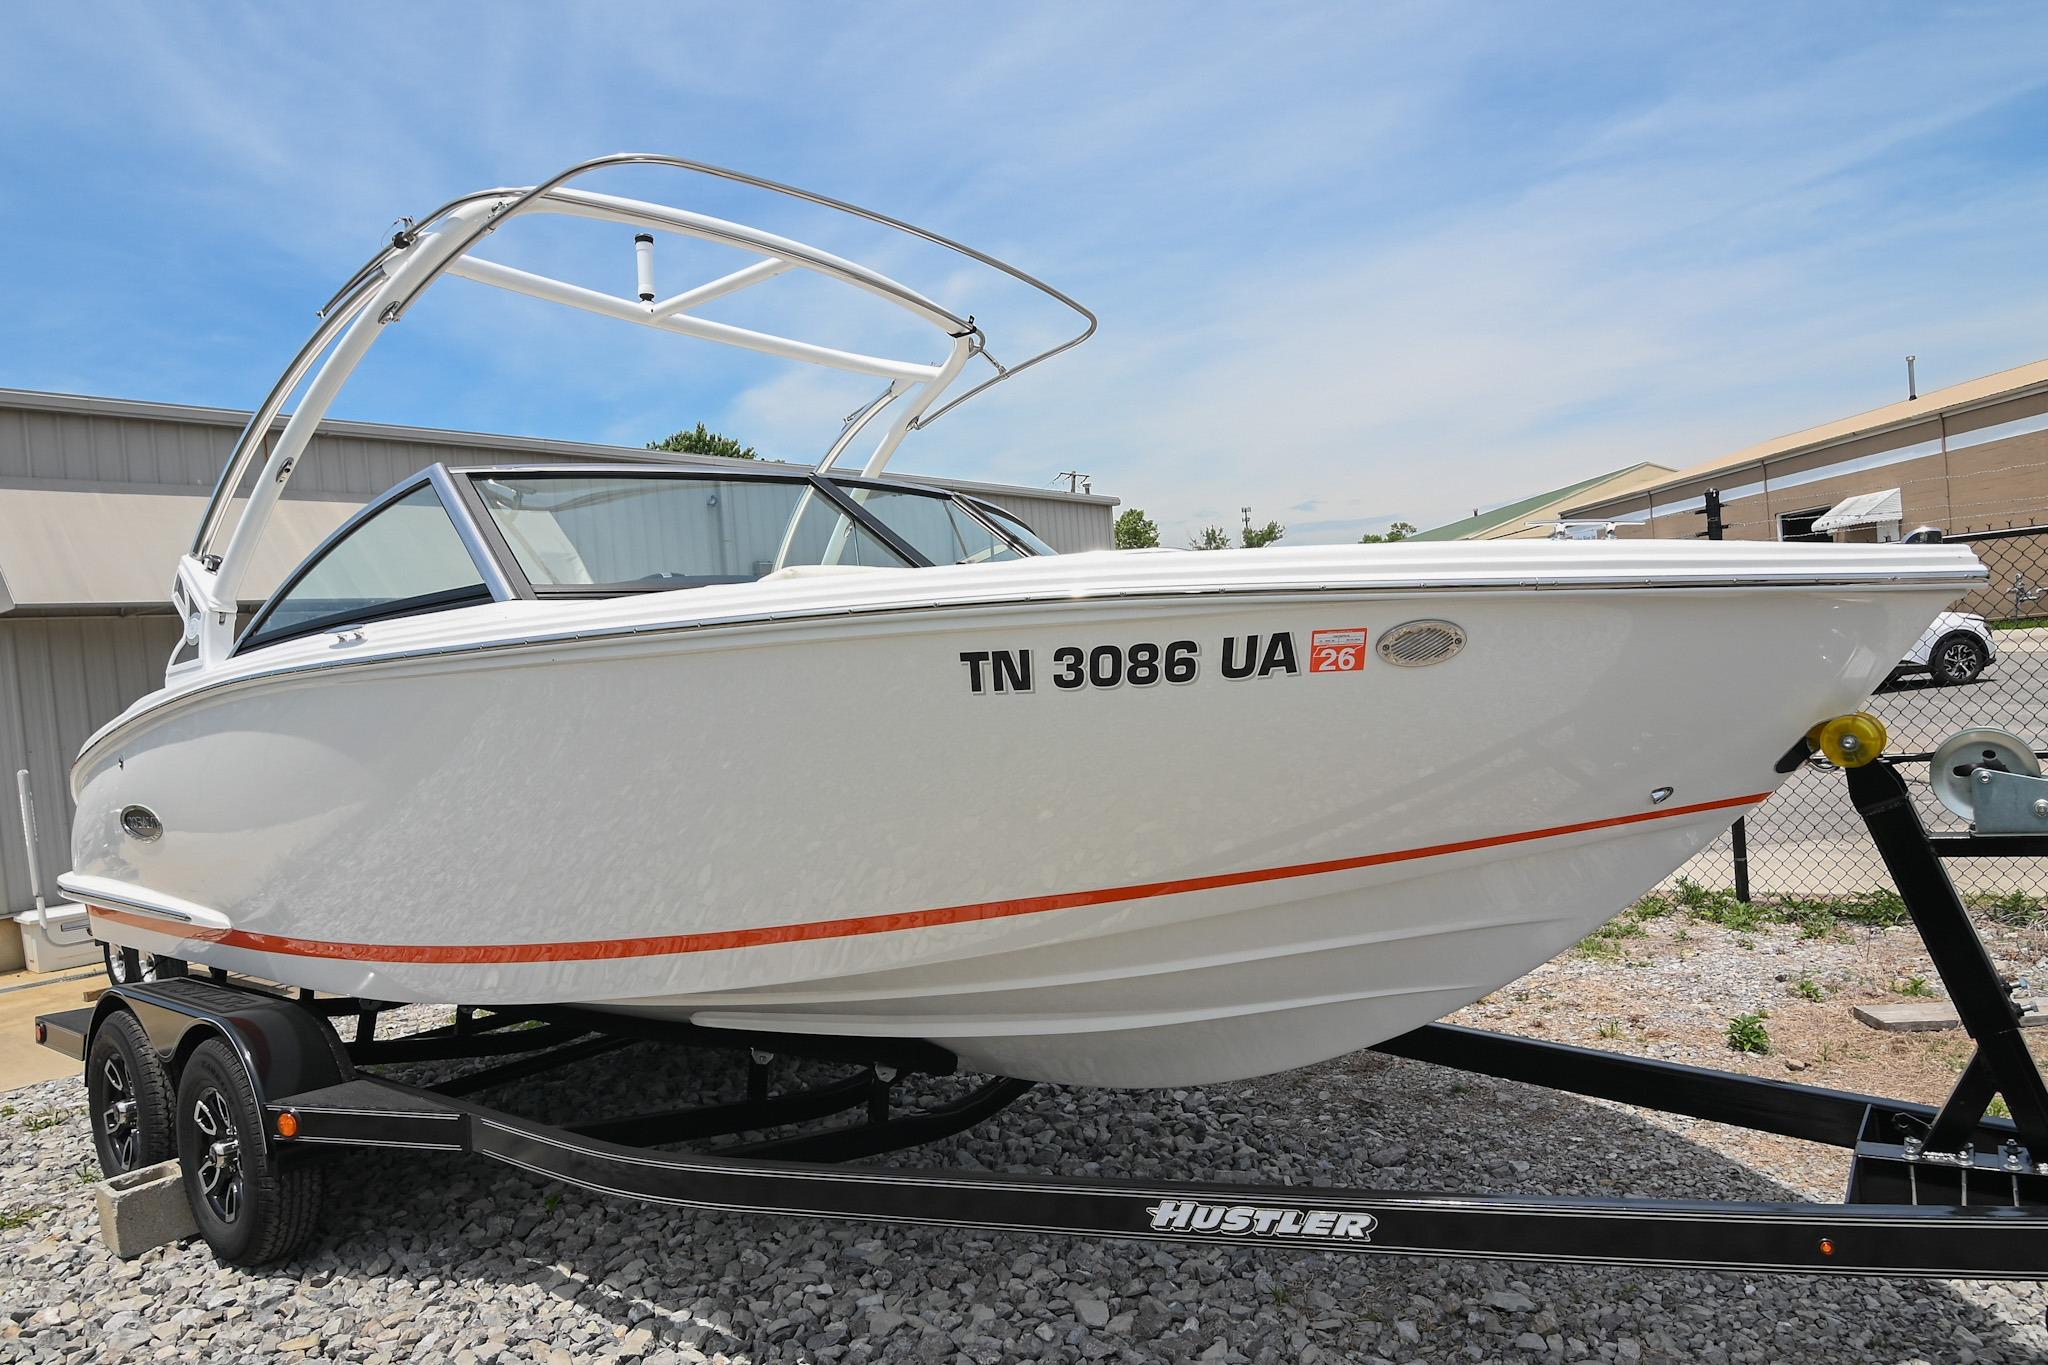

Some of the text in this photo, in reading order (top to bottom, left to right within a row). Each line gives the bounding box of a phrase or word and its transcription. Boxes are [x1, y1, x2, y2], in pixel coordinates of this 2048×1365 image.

[959, 631, 1299, 694] TN 3086 UA
[1318, 647, 1356, 671] 26
[1148, 1201, 1375, 1240] HUSTLER
